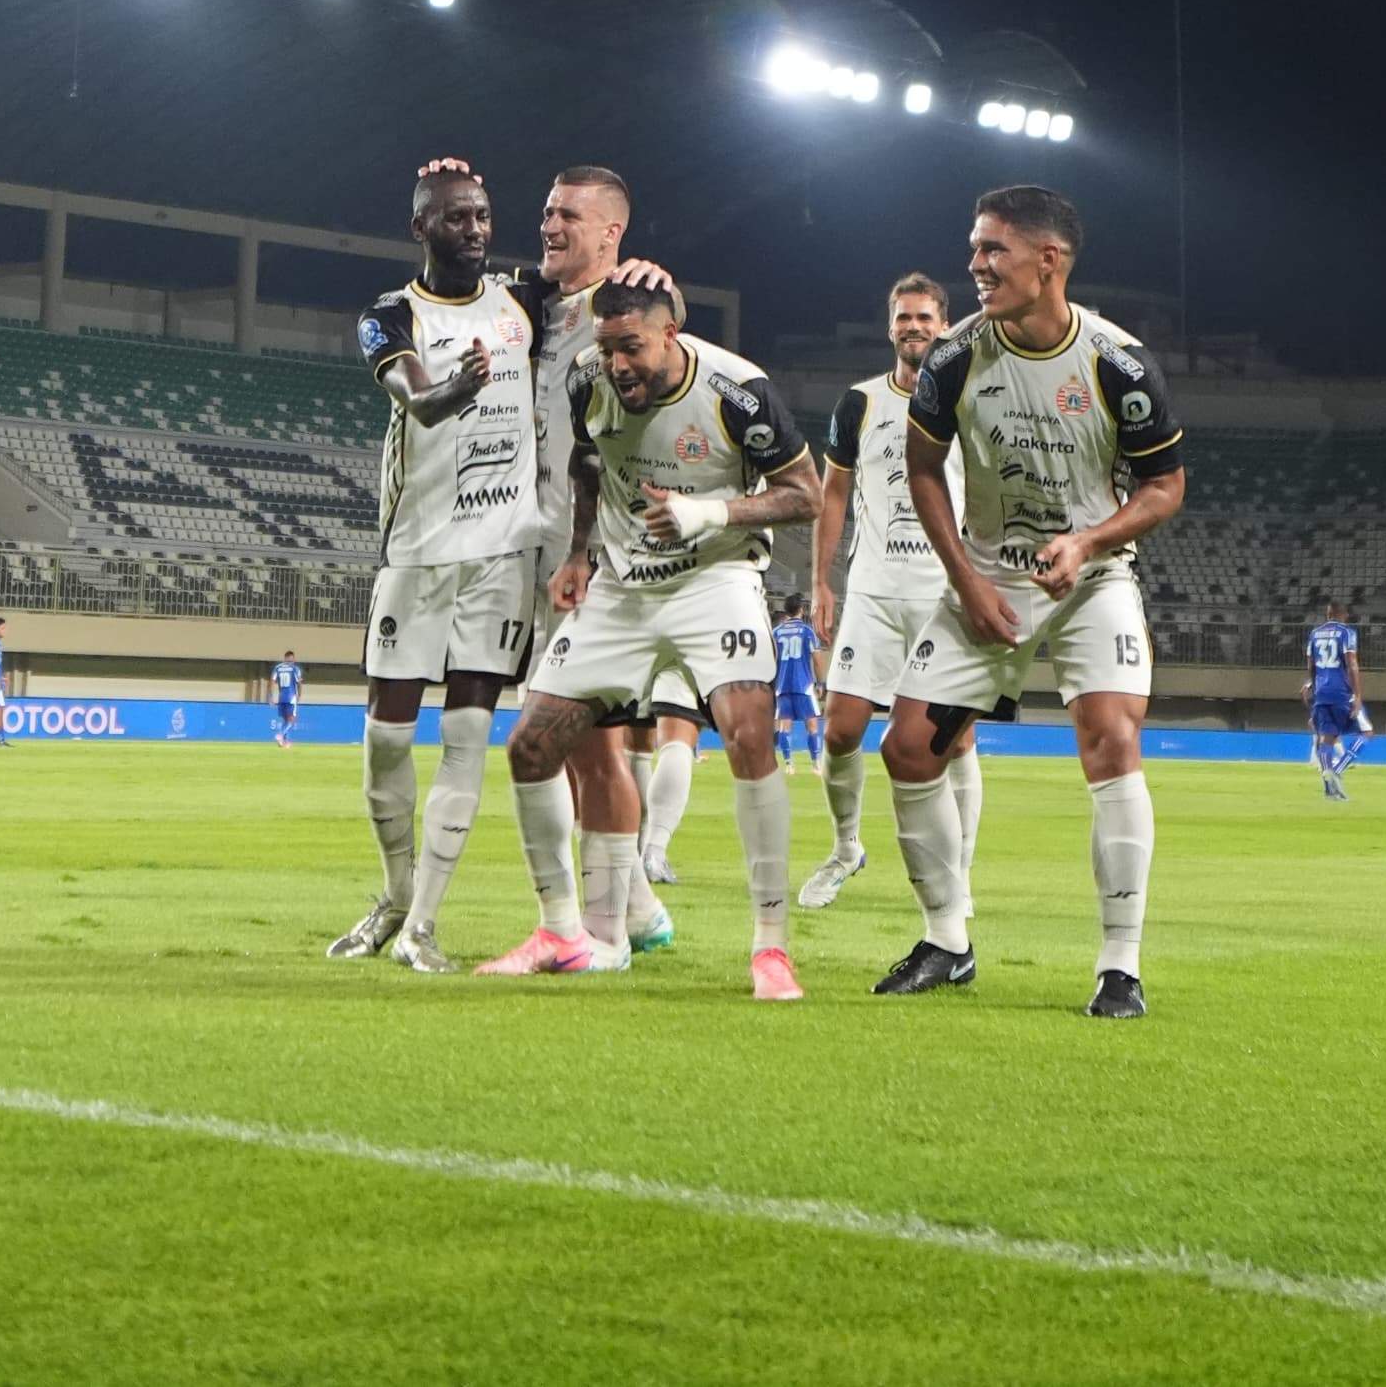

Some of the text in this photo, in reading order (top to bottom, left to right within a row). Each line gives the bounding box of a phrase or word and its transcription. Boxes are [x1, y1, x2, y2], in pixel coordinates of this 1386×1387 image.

[489, 347, 508, 357] AYA
[492, 368, 519, 382] arta
[479, 404, 519, 417] Bakrie
[1009, 435, 1075, 454] Jakarta
[499, 619, 524, 652] 17
[377, 639, 397, 649] TCT
[720, 629, 758, 660] 99
[778, 635, 802, 660] 20
[1113, 634, 1140, 667] 15
[1315, 639, 1340, 669] 32
[545, 656, 567, 668] TCT
[836, 661, 852, 672] TCT
[909, 660, 930, 672] TCT
[279, 672, 291, 688] 10
